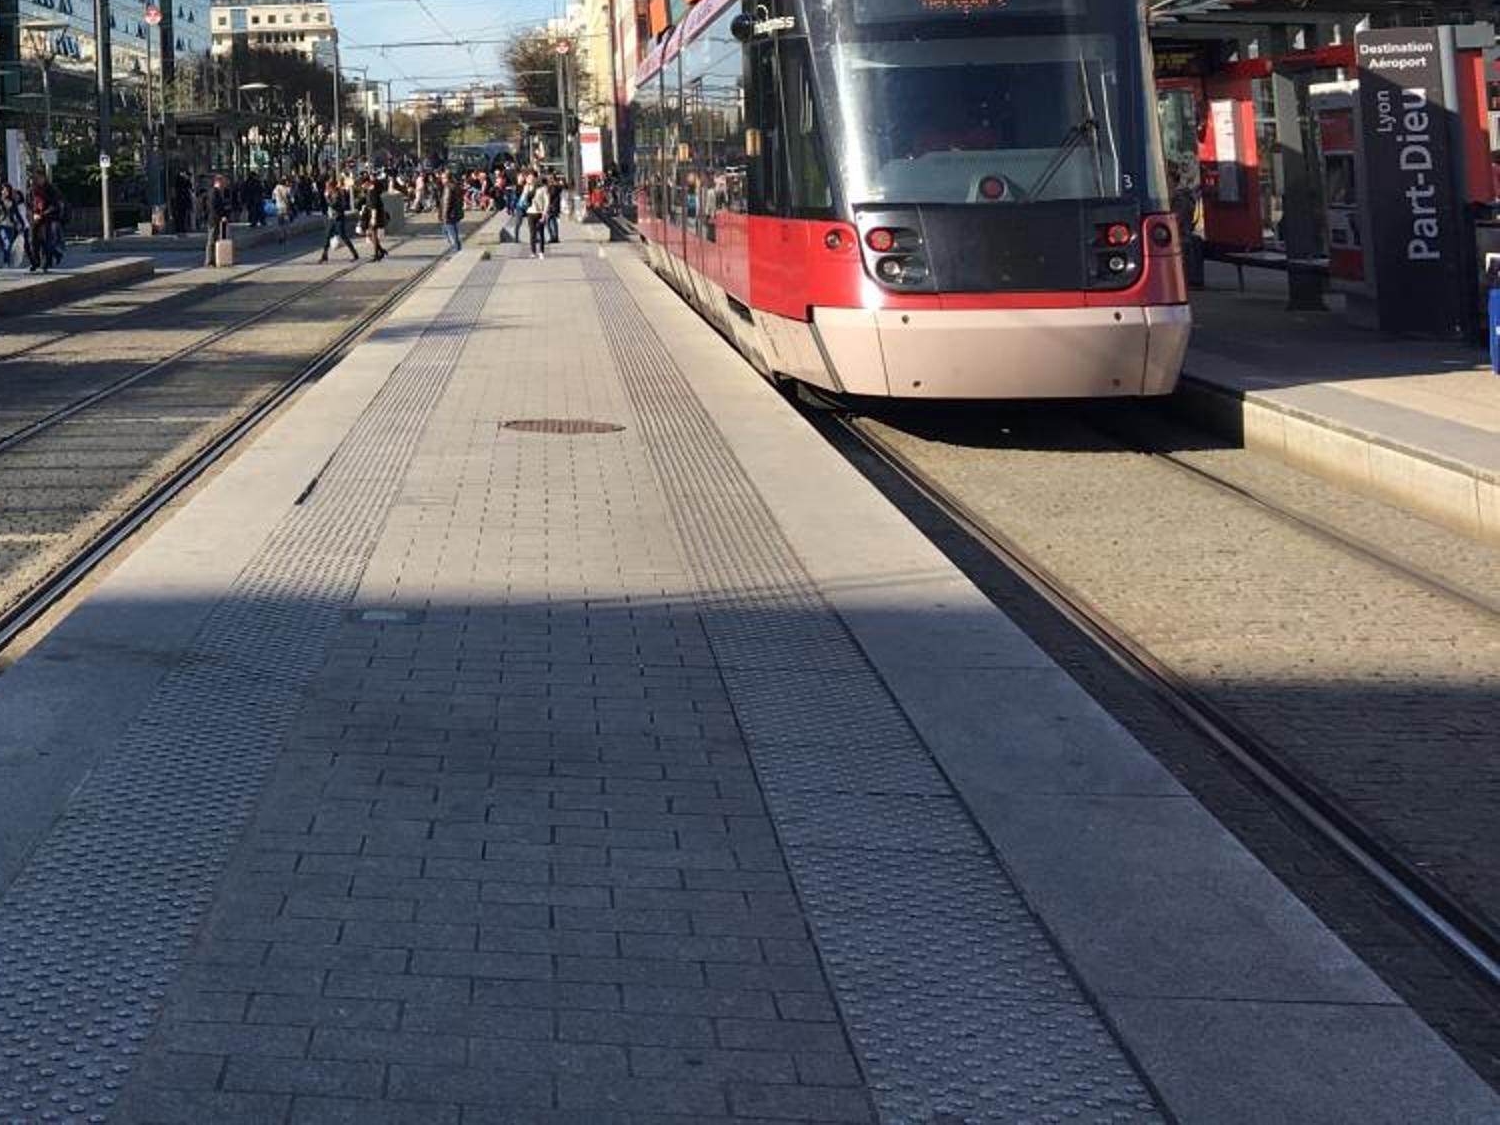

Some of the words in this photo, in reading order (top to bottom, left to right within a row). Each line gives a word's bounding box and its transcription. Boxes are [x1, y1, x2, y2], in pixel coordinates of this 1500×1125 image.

[1359, 41, 1433, 55] Destination
[1369, 56, 1427, 70] Aéroport
[1377, 90, 1396, 133] Lyon
[1397, 87, 1440, 260] Part-Dieu
